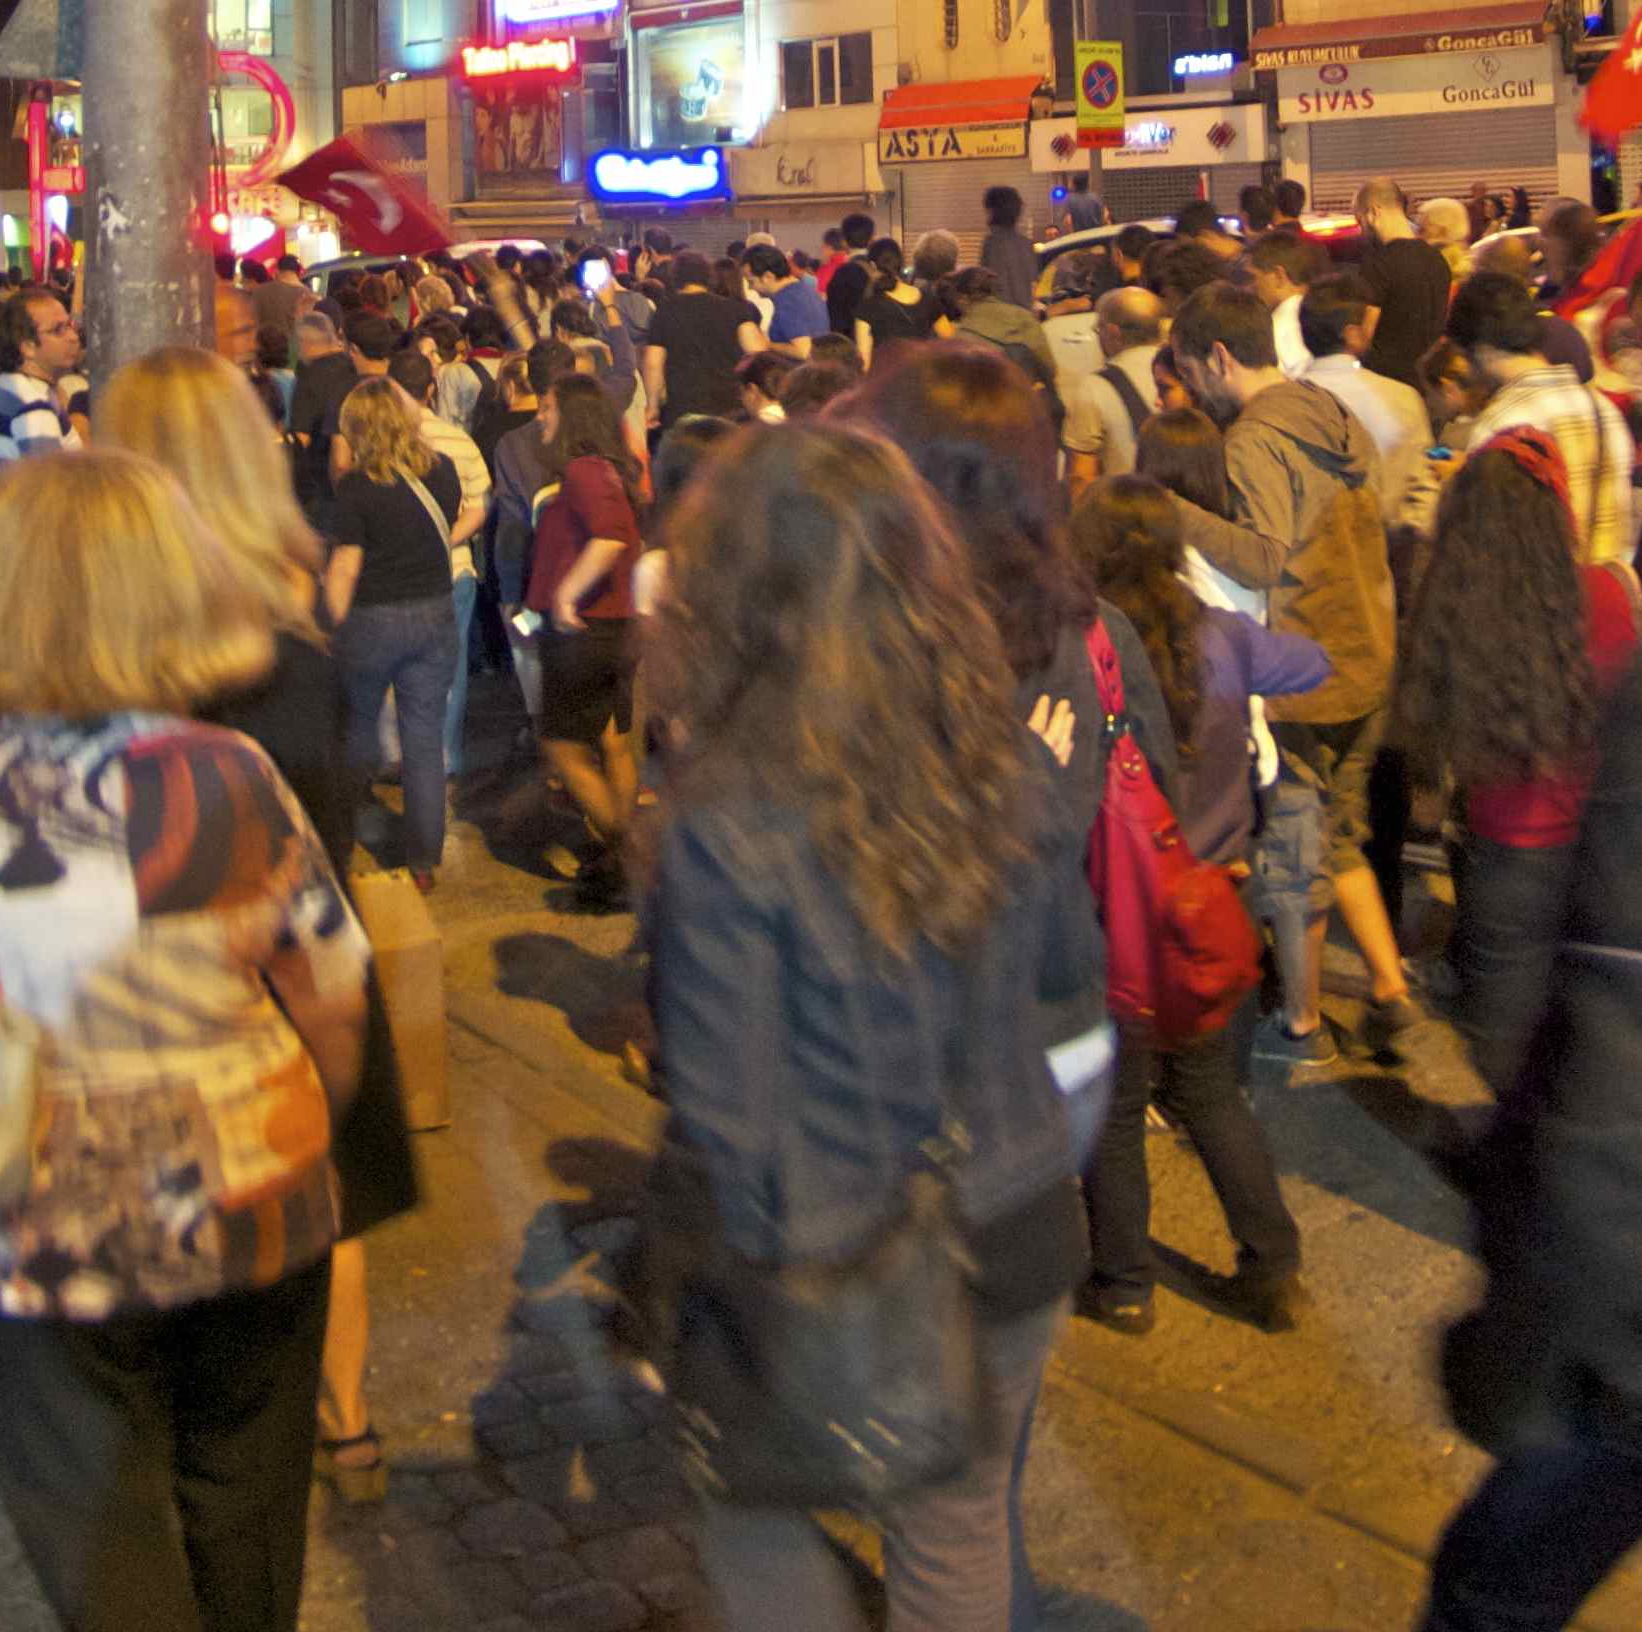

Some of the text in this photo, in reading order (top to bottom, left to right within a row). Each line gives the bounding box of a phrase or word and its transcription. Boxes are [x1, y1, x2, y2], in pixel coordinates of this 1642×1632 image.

[1436, 29, 1534, 51] GoncaGül
[1298, 87, 1375, 114] SİVAS
[1442, 78, 1536, 105] GoncaGül
[885, 128, 962, 159] ASTA
